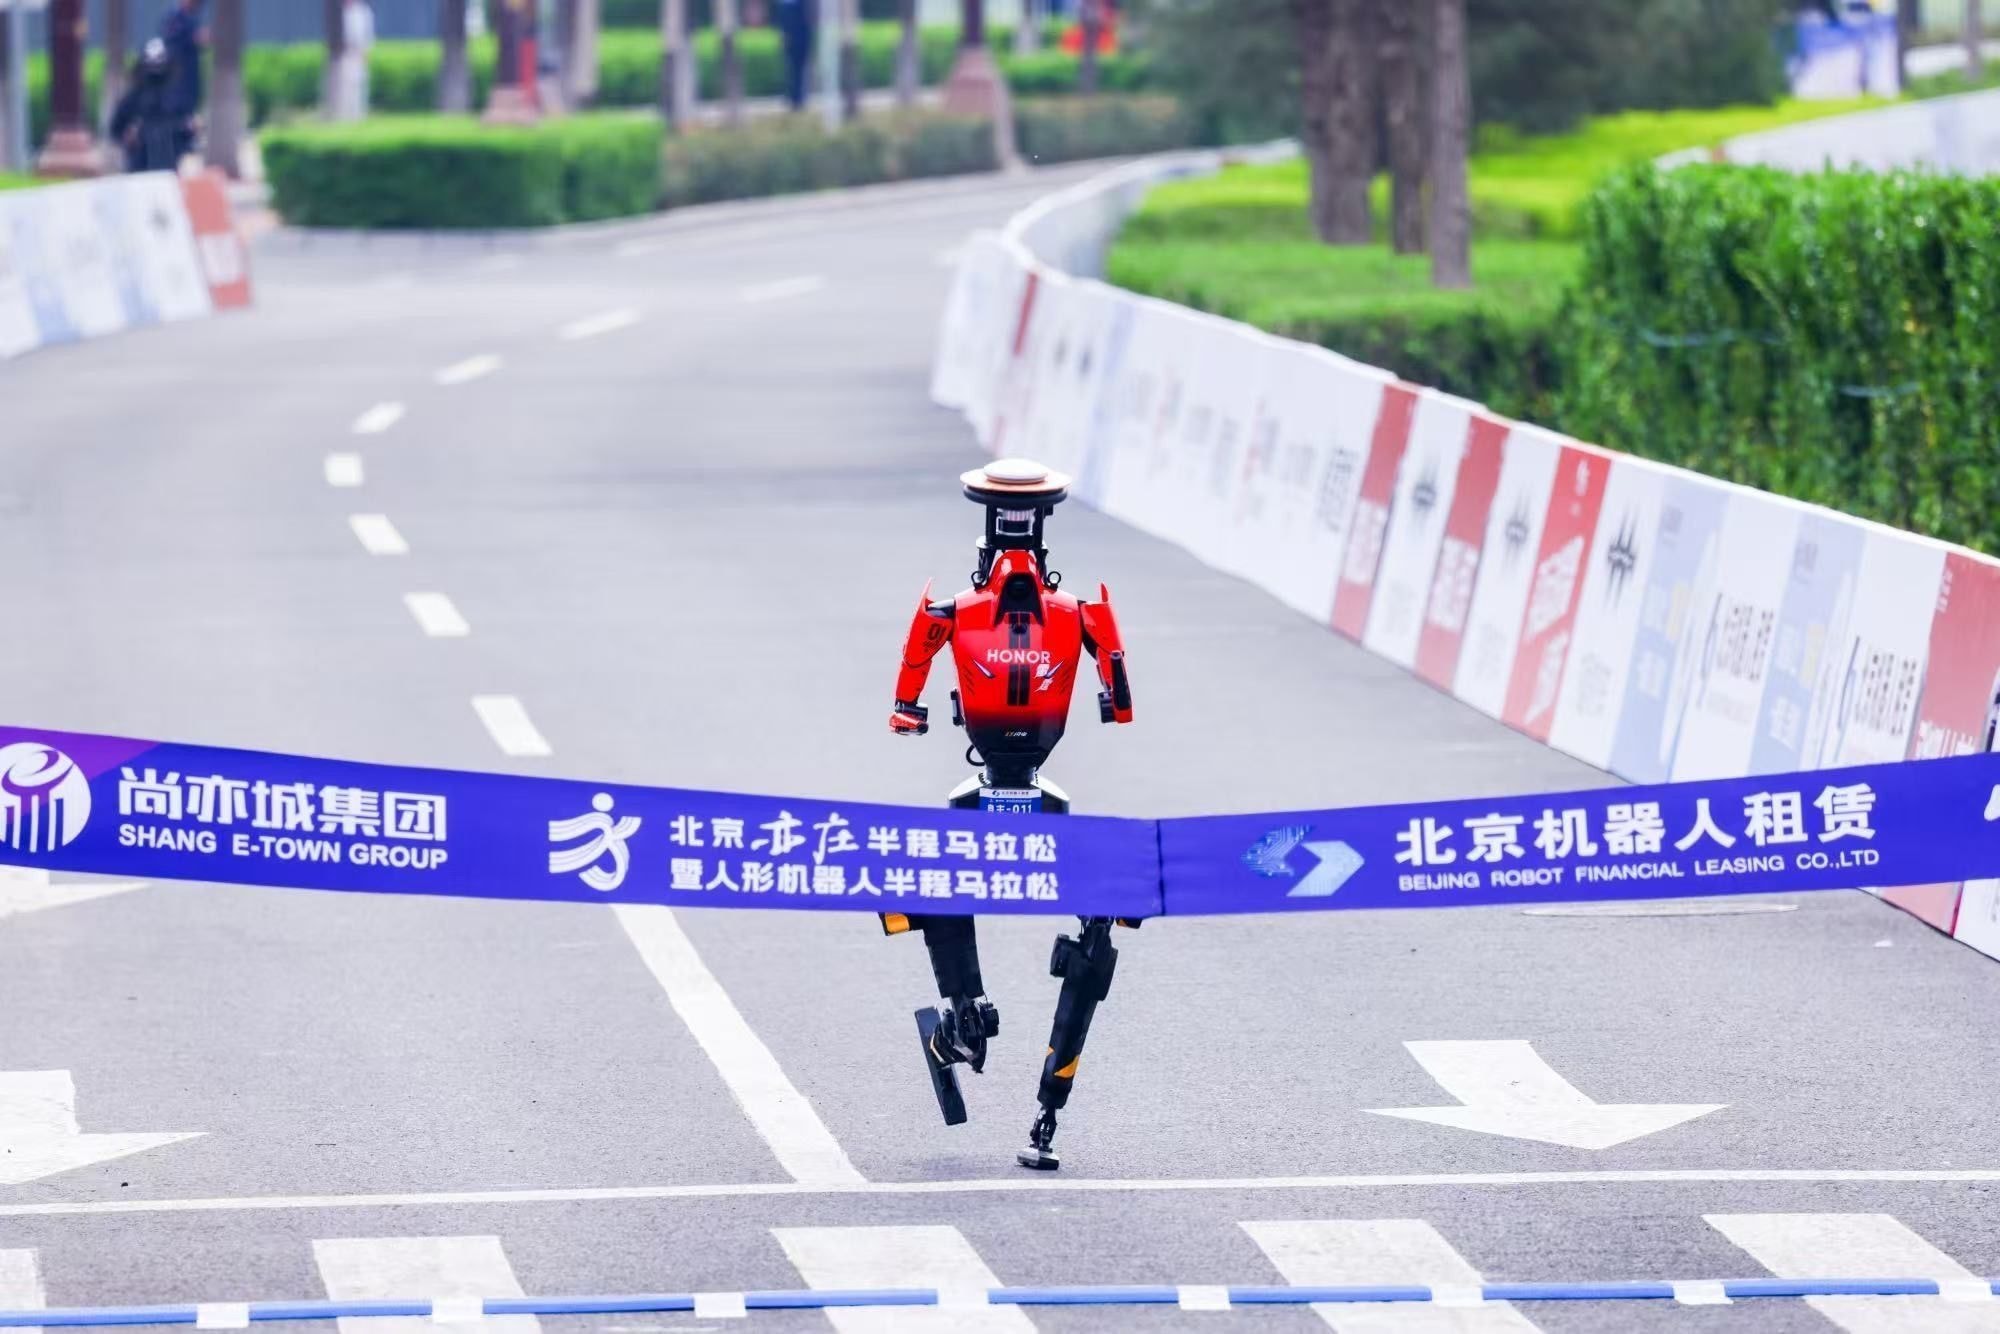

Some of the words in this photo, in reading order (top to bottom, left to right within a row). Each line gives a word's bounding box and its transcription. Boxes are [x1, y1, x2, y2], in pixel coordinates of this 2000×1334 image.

[986, 649, 1051, 664] HONOR
[118, 767, 447, 842] 尚亦城集团
[1394, 783, 1876, 866] 北京机器人租赁
[118, 824, 217, 854] SHANG
[232, 834, 341, 863] E-TOWN
[348, 843, 448, 870] GROUP
[670, 858, 1059, 901] 暨人形机器人半程马拉松
[1398, 873, 1480, 891] BEIJING
[1490, 867, 1564, 887] ROBOT
[1575, 863, 1684, 882] FINANCIAL
[1694, 856, 1785, 876] LEASING
[1796, 850, 1880, 870] CO.,LTD
